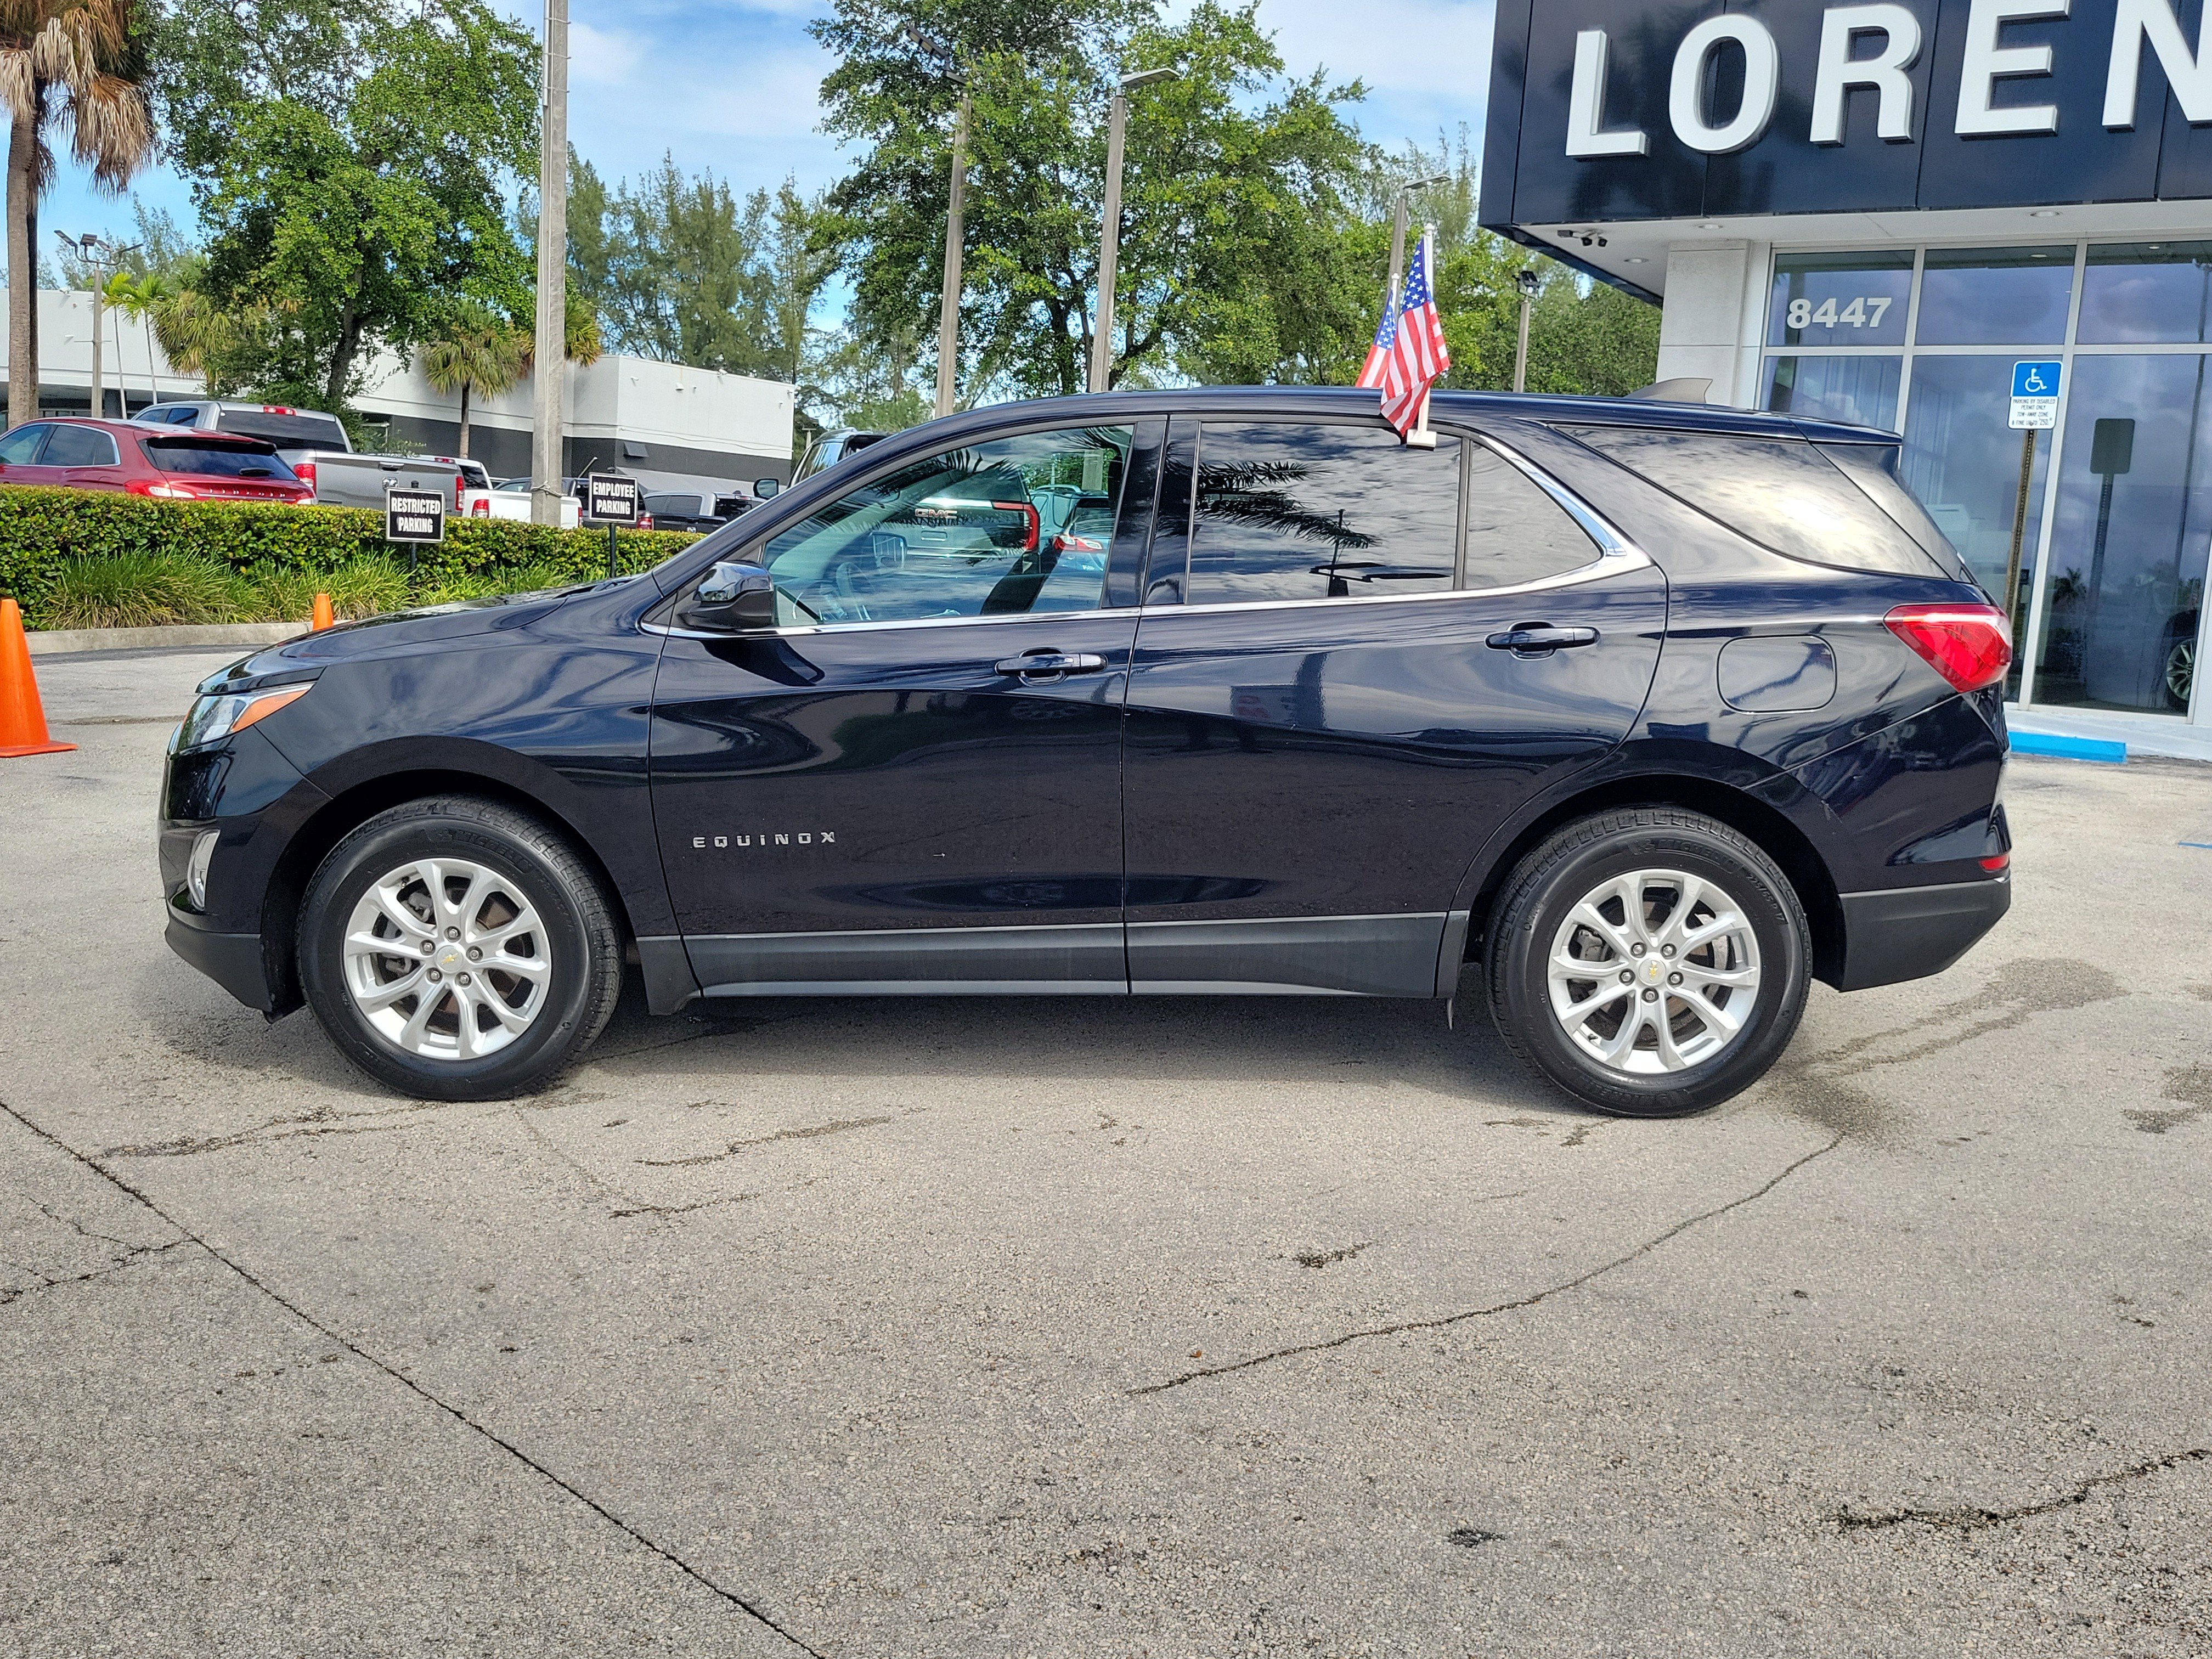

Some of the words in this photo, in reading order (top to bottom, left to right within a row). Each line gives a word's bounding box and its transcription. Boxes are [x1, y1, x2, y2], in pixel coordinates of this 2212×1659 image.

[1565, 0, 2212, 158] LOREN
[1787, 297, 1892, 329] 8447
[593, 482, 634, 498] EMPLOYEE
[391, 497, 441, 515] RESTRICTED
[596, 499, 631, 515] PARKING
[915, 508, 958, 519] GMC
[398, 516, 433, 533] PARKING
[692, 832, 836, 848] EQUINOX
